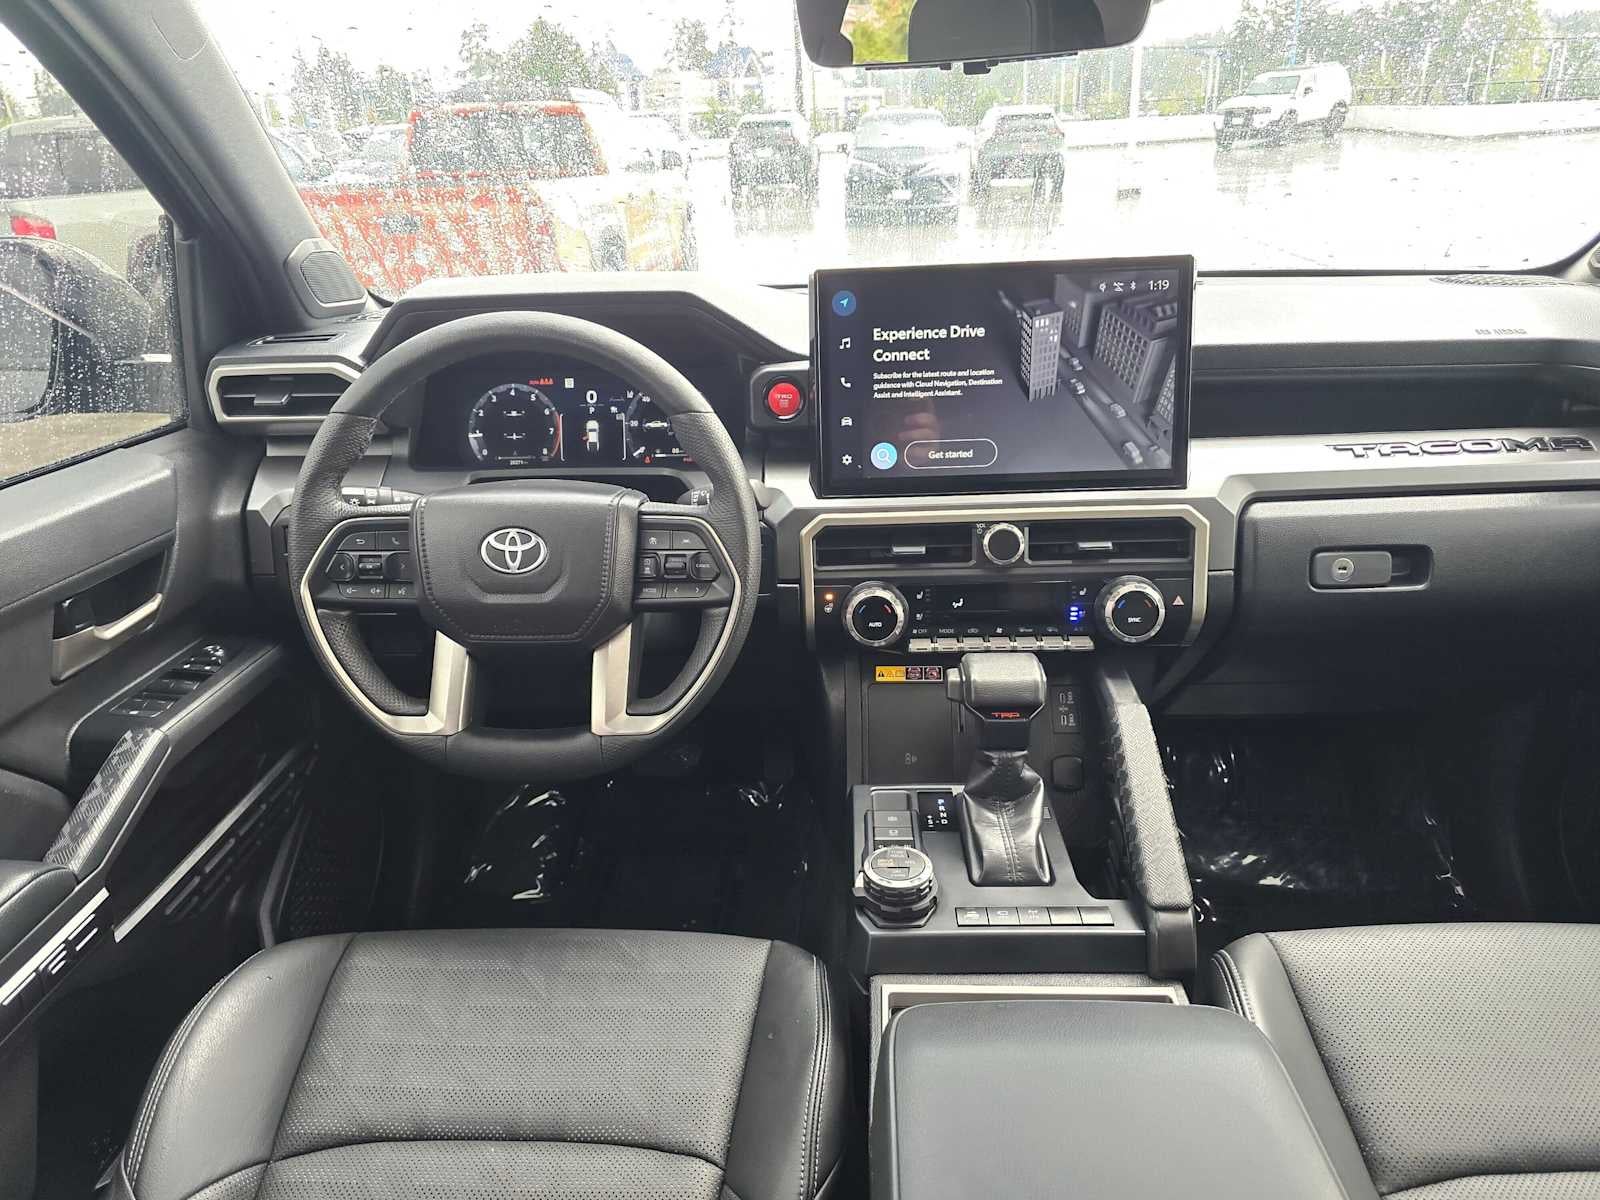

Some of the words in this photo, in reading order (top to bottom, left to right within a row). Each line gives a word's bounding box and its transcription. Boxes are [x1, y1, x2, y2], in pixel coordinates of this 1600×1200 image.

[1148, 279, 1170, 291] 1:19
[873, 326, 948, 343] Experience
[950, 324, 986, 338] Drive
[873, 348, 931, 362] Connect
[923, 370, 940, 378] latest
[873, 381, 901, 390] guidance
[901, 380, 915, 388] with
[934, 379, 968, 388] Navigation,
[968, 378, 1003, 386] Destination
[510, 388, 515, 396] 4
[530, 393, 537, 401] 5
[873, 391, 891, 399] Assist
[891, 390, 903, 398] and
[904, 390, 934, 398] Intelligent
[549, 427, 555, 435] 7
[1325, 436, 1596, 459] TACOMA
[928, 450, 944, 459] Get
[945, 449, 974, 459] started
